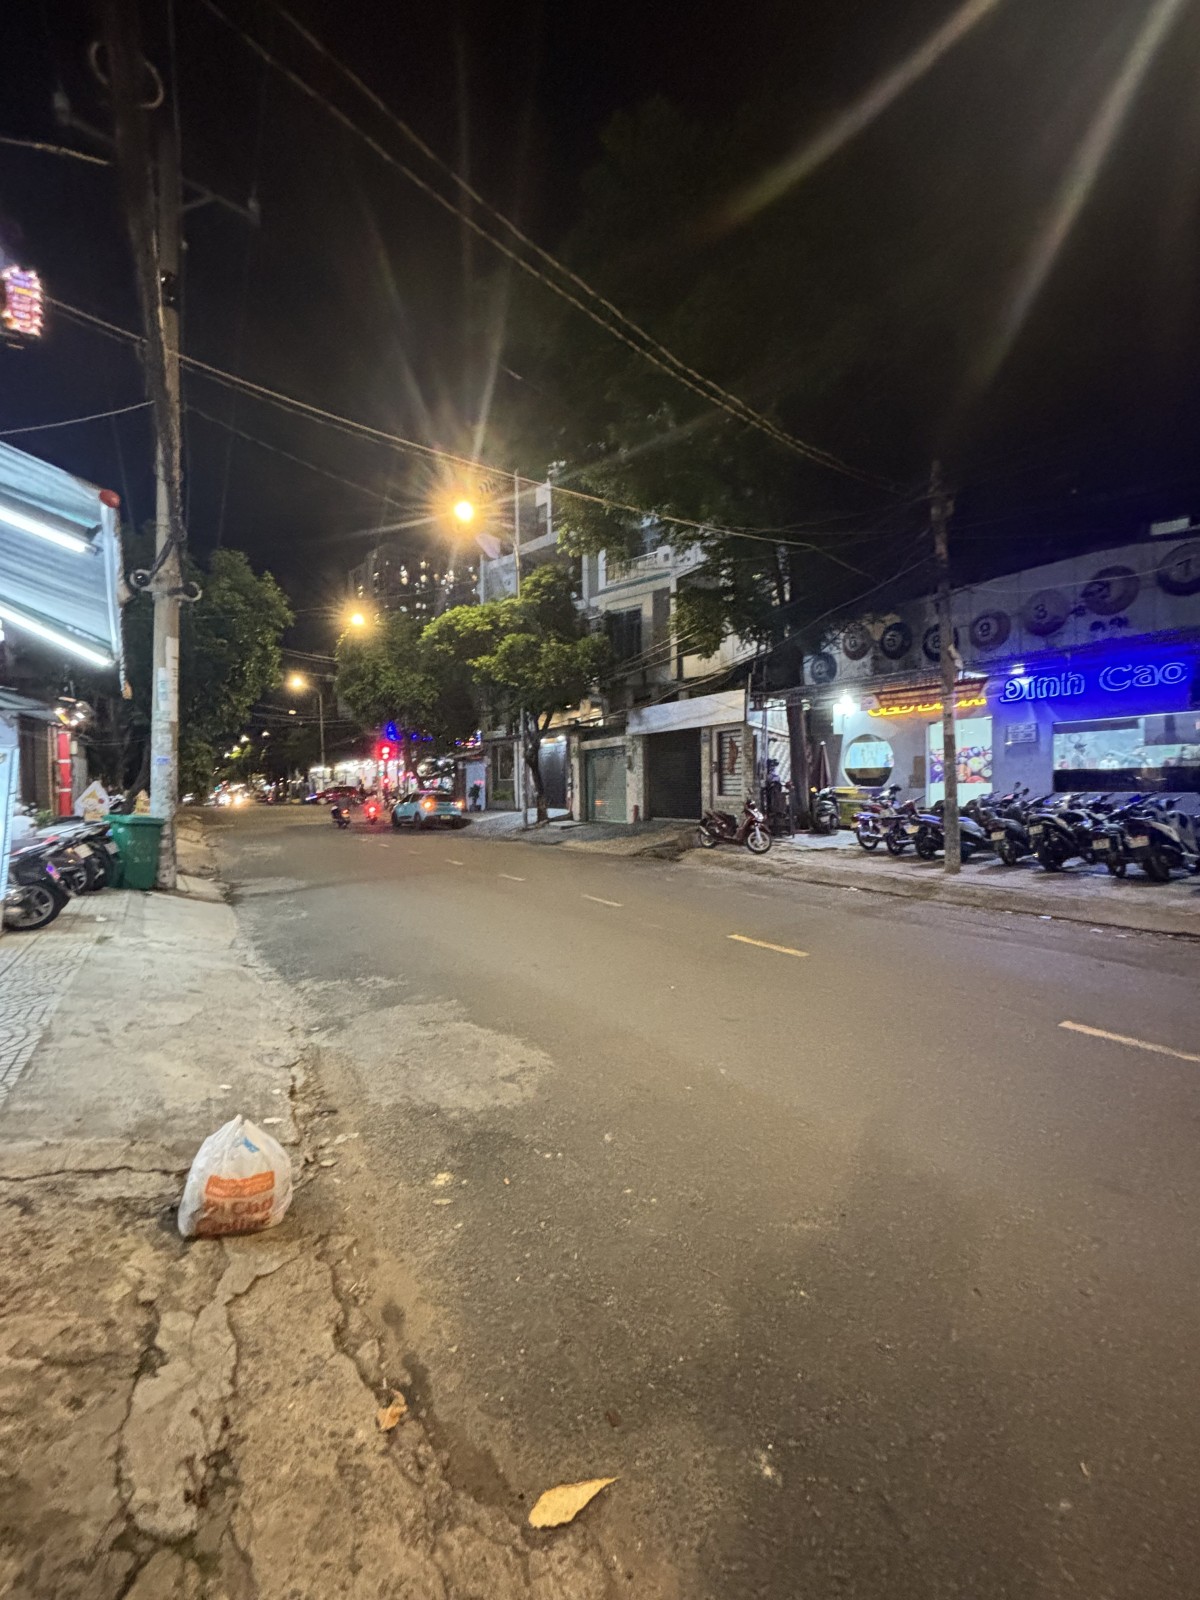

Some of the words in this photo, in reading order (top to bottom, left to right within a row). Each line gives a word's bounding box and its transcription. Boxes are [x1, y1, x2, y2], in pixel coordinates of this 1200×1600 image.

[1033, 603, 1047, 620] 3
[979, 622, 991, 636] 9
[1098, 661, 1189, 692] Cao
